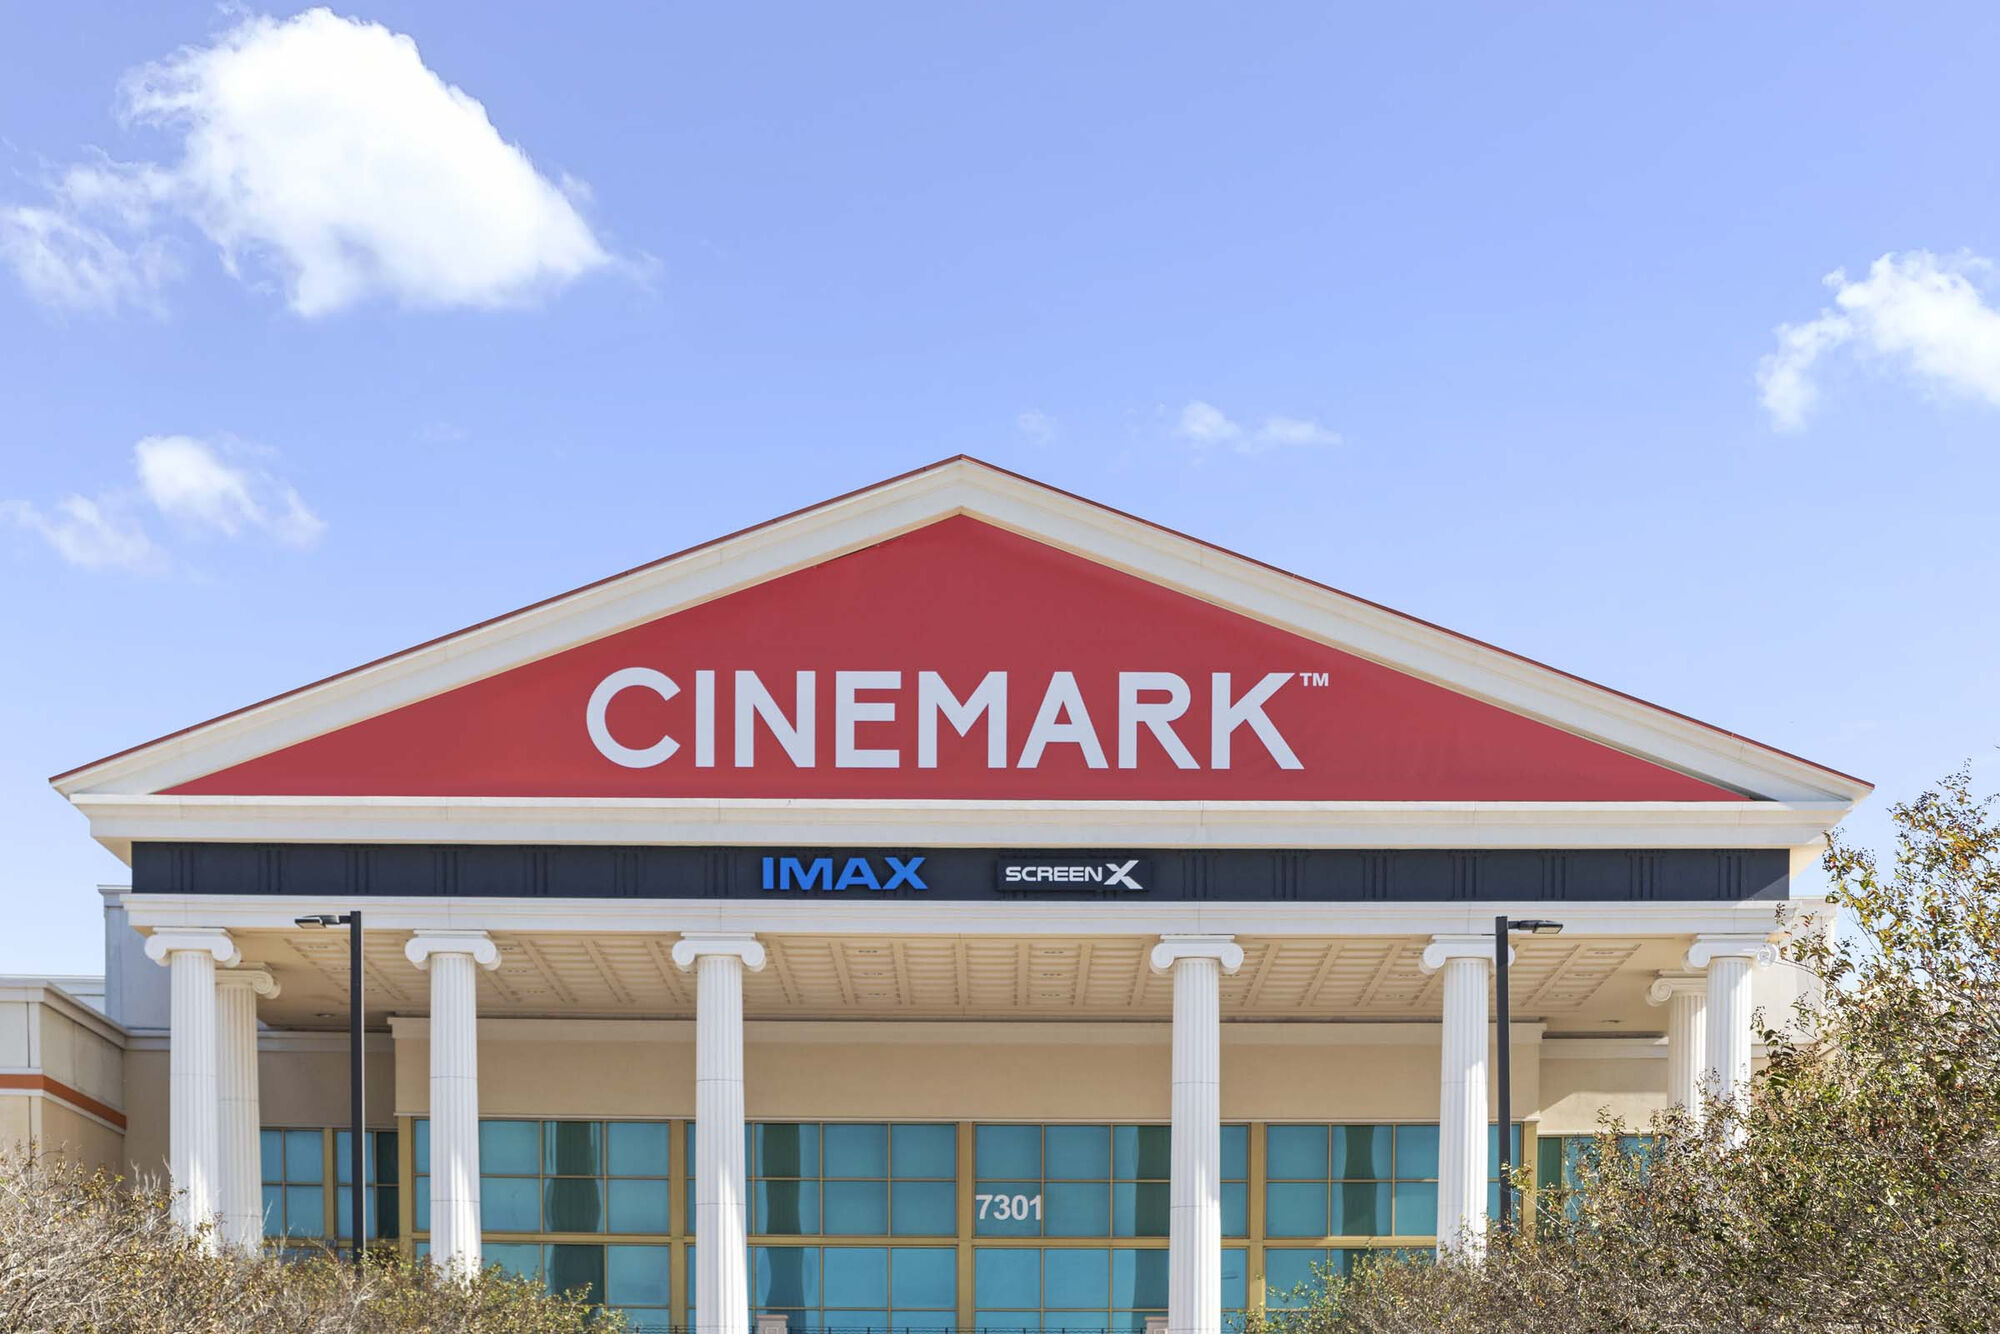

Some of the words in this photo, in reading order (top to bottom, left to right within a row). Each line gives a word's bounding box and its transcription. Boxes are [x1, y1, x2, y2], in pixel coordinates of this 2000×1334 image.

[586, 666, 1305, 770] CINEMARK
[762, 856, 928, 891] IMAX
[975, 1194, 1043, 1221] 7301
